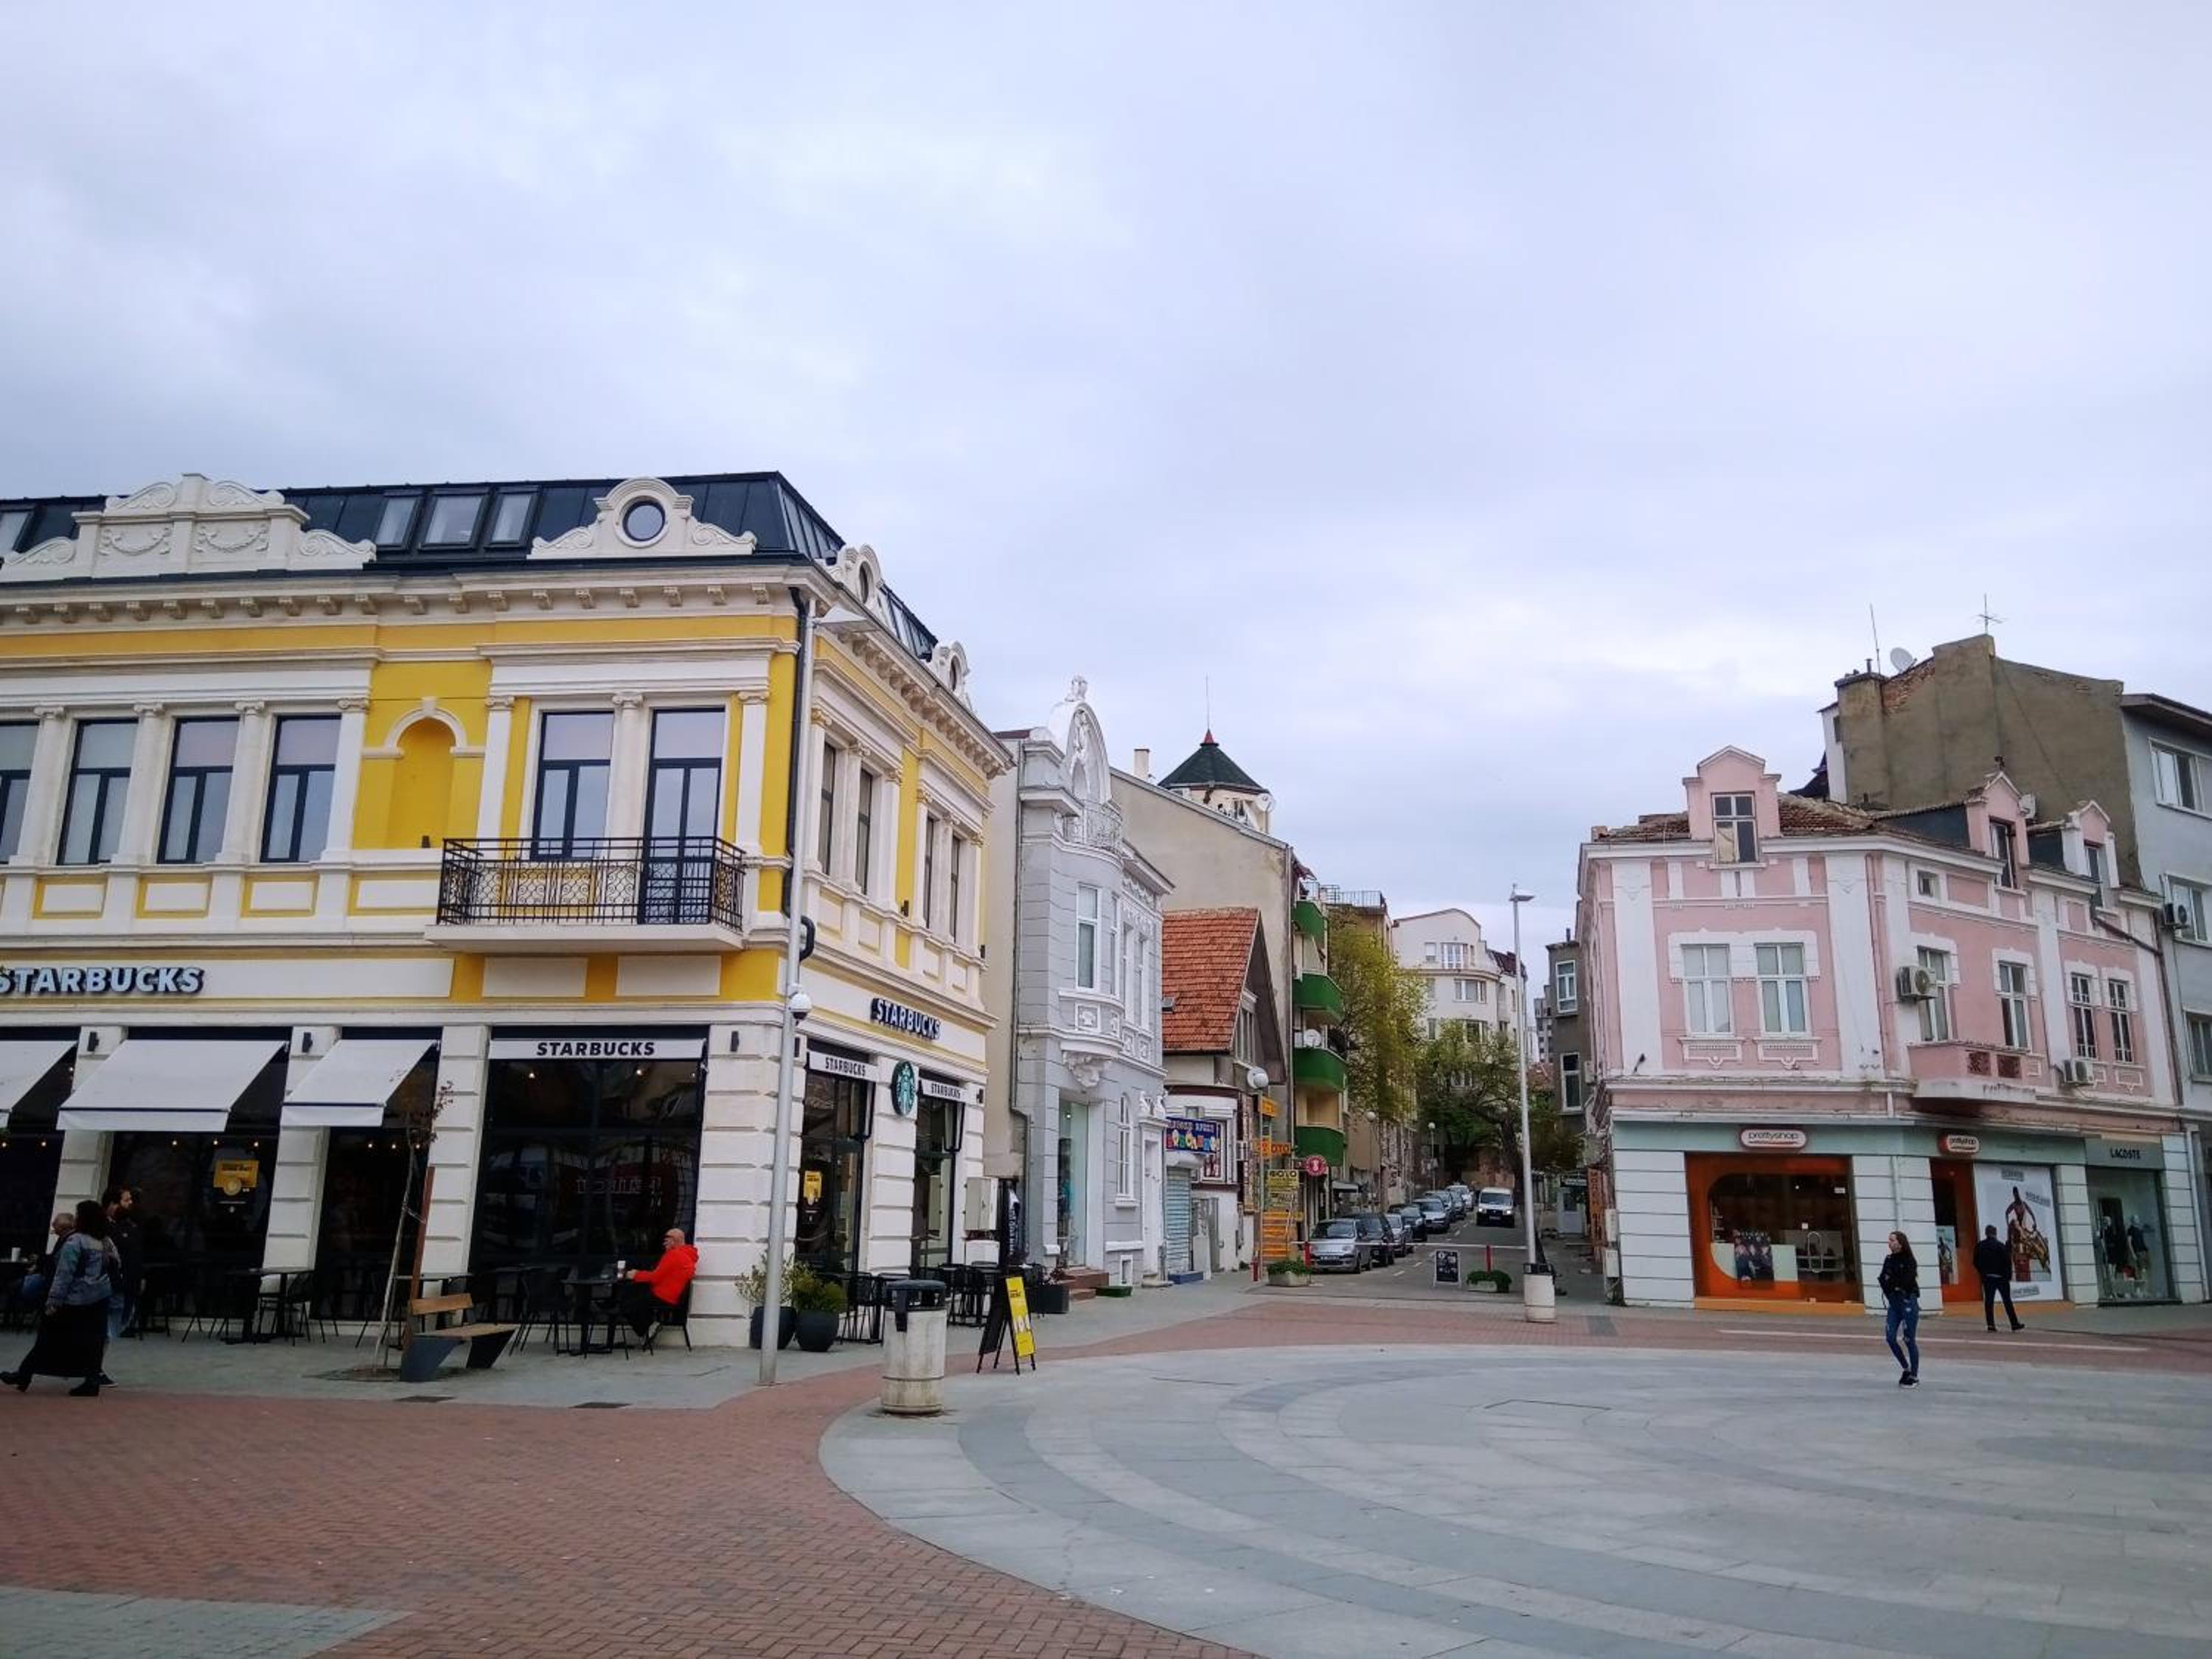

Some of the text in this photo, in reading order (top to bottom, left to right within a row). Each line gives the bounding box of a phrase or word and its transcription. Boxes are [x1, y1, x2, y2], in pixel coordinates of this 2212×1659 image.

[875, 999, 941, 1040] STARBUCKS
[537, 1042, 655, 1057] STARBUCKS
[825, 1057, 866, 1077] STARBUCKS
[931, 1083, 961, 1099] STARBUCKS
[2110, 1148, 2140, 1160] LACOSTE
